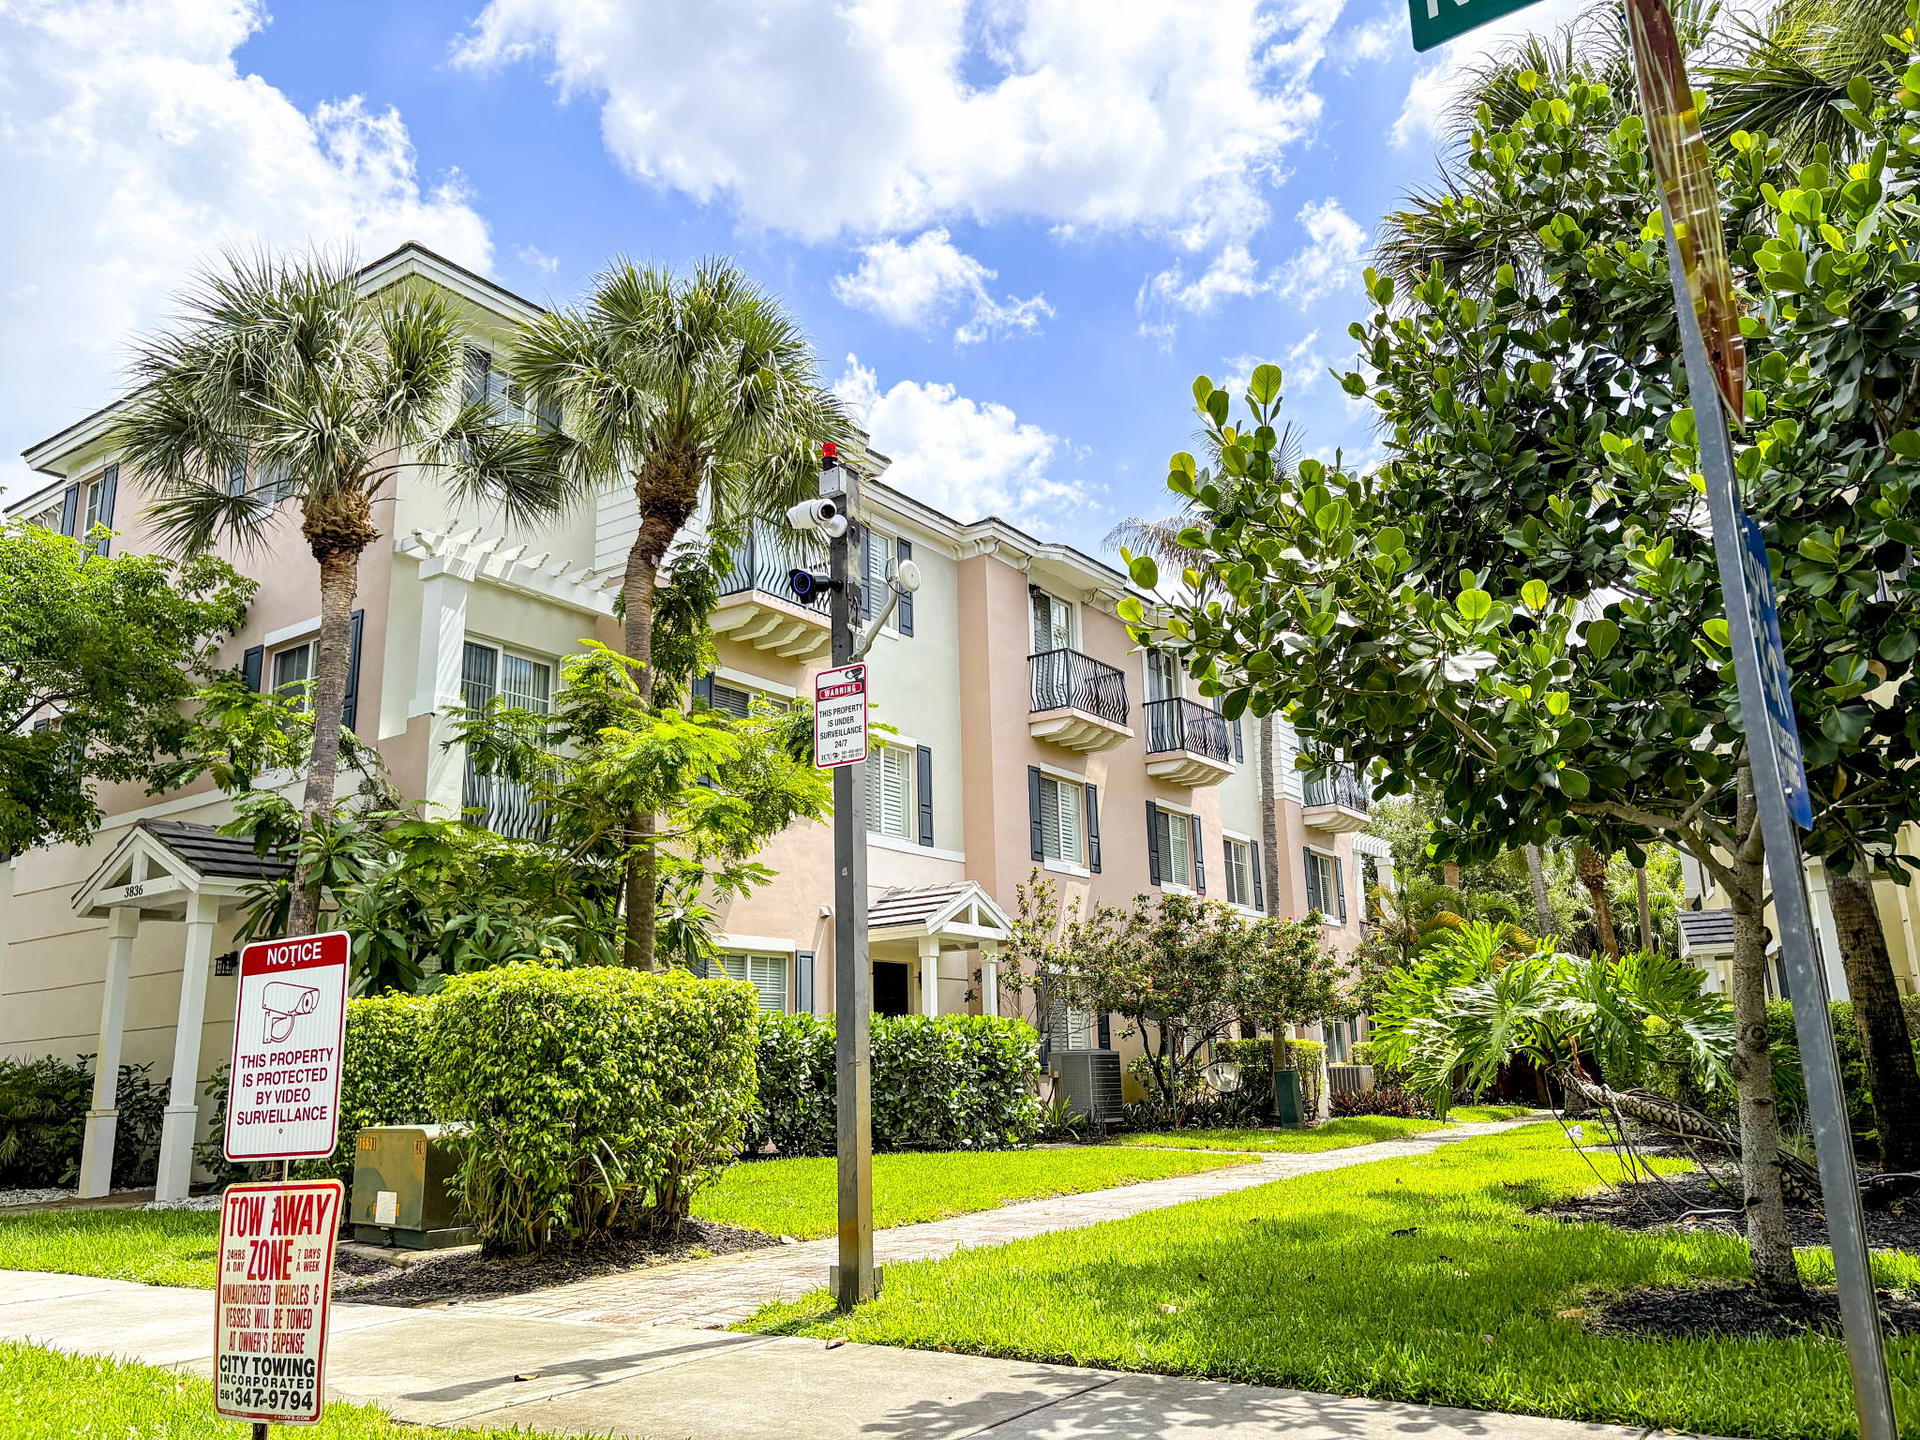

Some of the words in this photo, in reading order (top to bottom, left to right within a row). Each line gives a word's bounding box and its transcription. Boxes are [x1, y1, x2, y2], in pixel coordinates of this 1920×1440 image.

[824, 684, 856, 698] WARNING
[819, 708, 832, 719] THIS
[833, 703, 863, 716] PROPERTY
[827, 719, 834, 728] IS
[834, 716, 855, 727] UNDER
[819, 725, 863, 741] SURVEILLANCE
[834, 739, 848, 749] 24/7
[124, 884, 144, 899] 3836
[266, 941, 323, 966] NOTICE
[240, 1053, 266, 1069] THIS
[269, 1047, 334, 1066] PROPERTY
[242, 1073, 253, 1087] IS
[256, 1067, 328, 1086] PROTECTED
[255, 1090, 272, 1105] BY
[274, 1087, 311, 1104] VIDEO
[236, 1106, 328, 1126] SURVEILLANCE
[229, 1195, 266, 1238] TOW
[269, 1193, 332, 1236] AWAY
[227, 1249, 246, 1260] 24HRS
[246, 1239, 294, 1281] ZONE
[297, 1249, 302, 1260] 7
[303, 1248, 321, 1260] DAYS
[226, 1262, 231, 1272] A
[233, 1261, 245, 1272] DAY
[296, 1261, 301, 1272] A
[303, 1260, 320, 1272] WEEK
[222, 1284, 272, 1305] UNAUTHORIZED
[275, 1284, 310, 1305] VEHICLES
[313, 1284, 320, 1305] &
[225, 1308, 252, 1328] VESSELS
[254, 1308, 270, 1329] WILL
[273, 1308, 283, 1330] BE
[286, 1308, 313, 1330] TOWED
[228, 1331, 237, 1351] AT
[238, 1331, 269, 1353] OWNER'S
[271, 1332, 306, 1354] EXPENSE
[219, 1354, 249, 1374] CITY
[252, 1357, 316, 1377] TOWING
[219, 1373, 315, 1389] INCORPORATED
